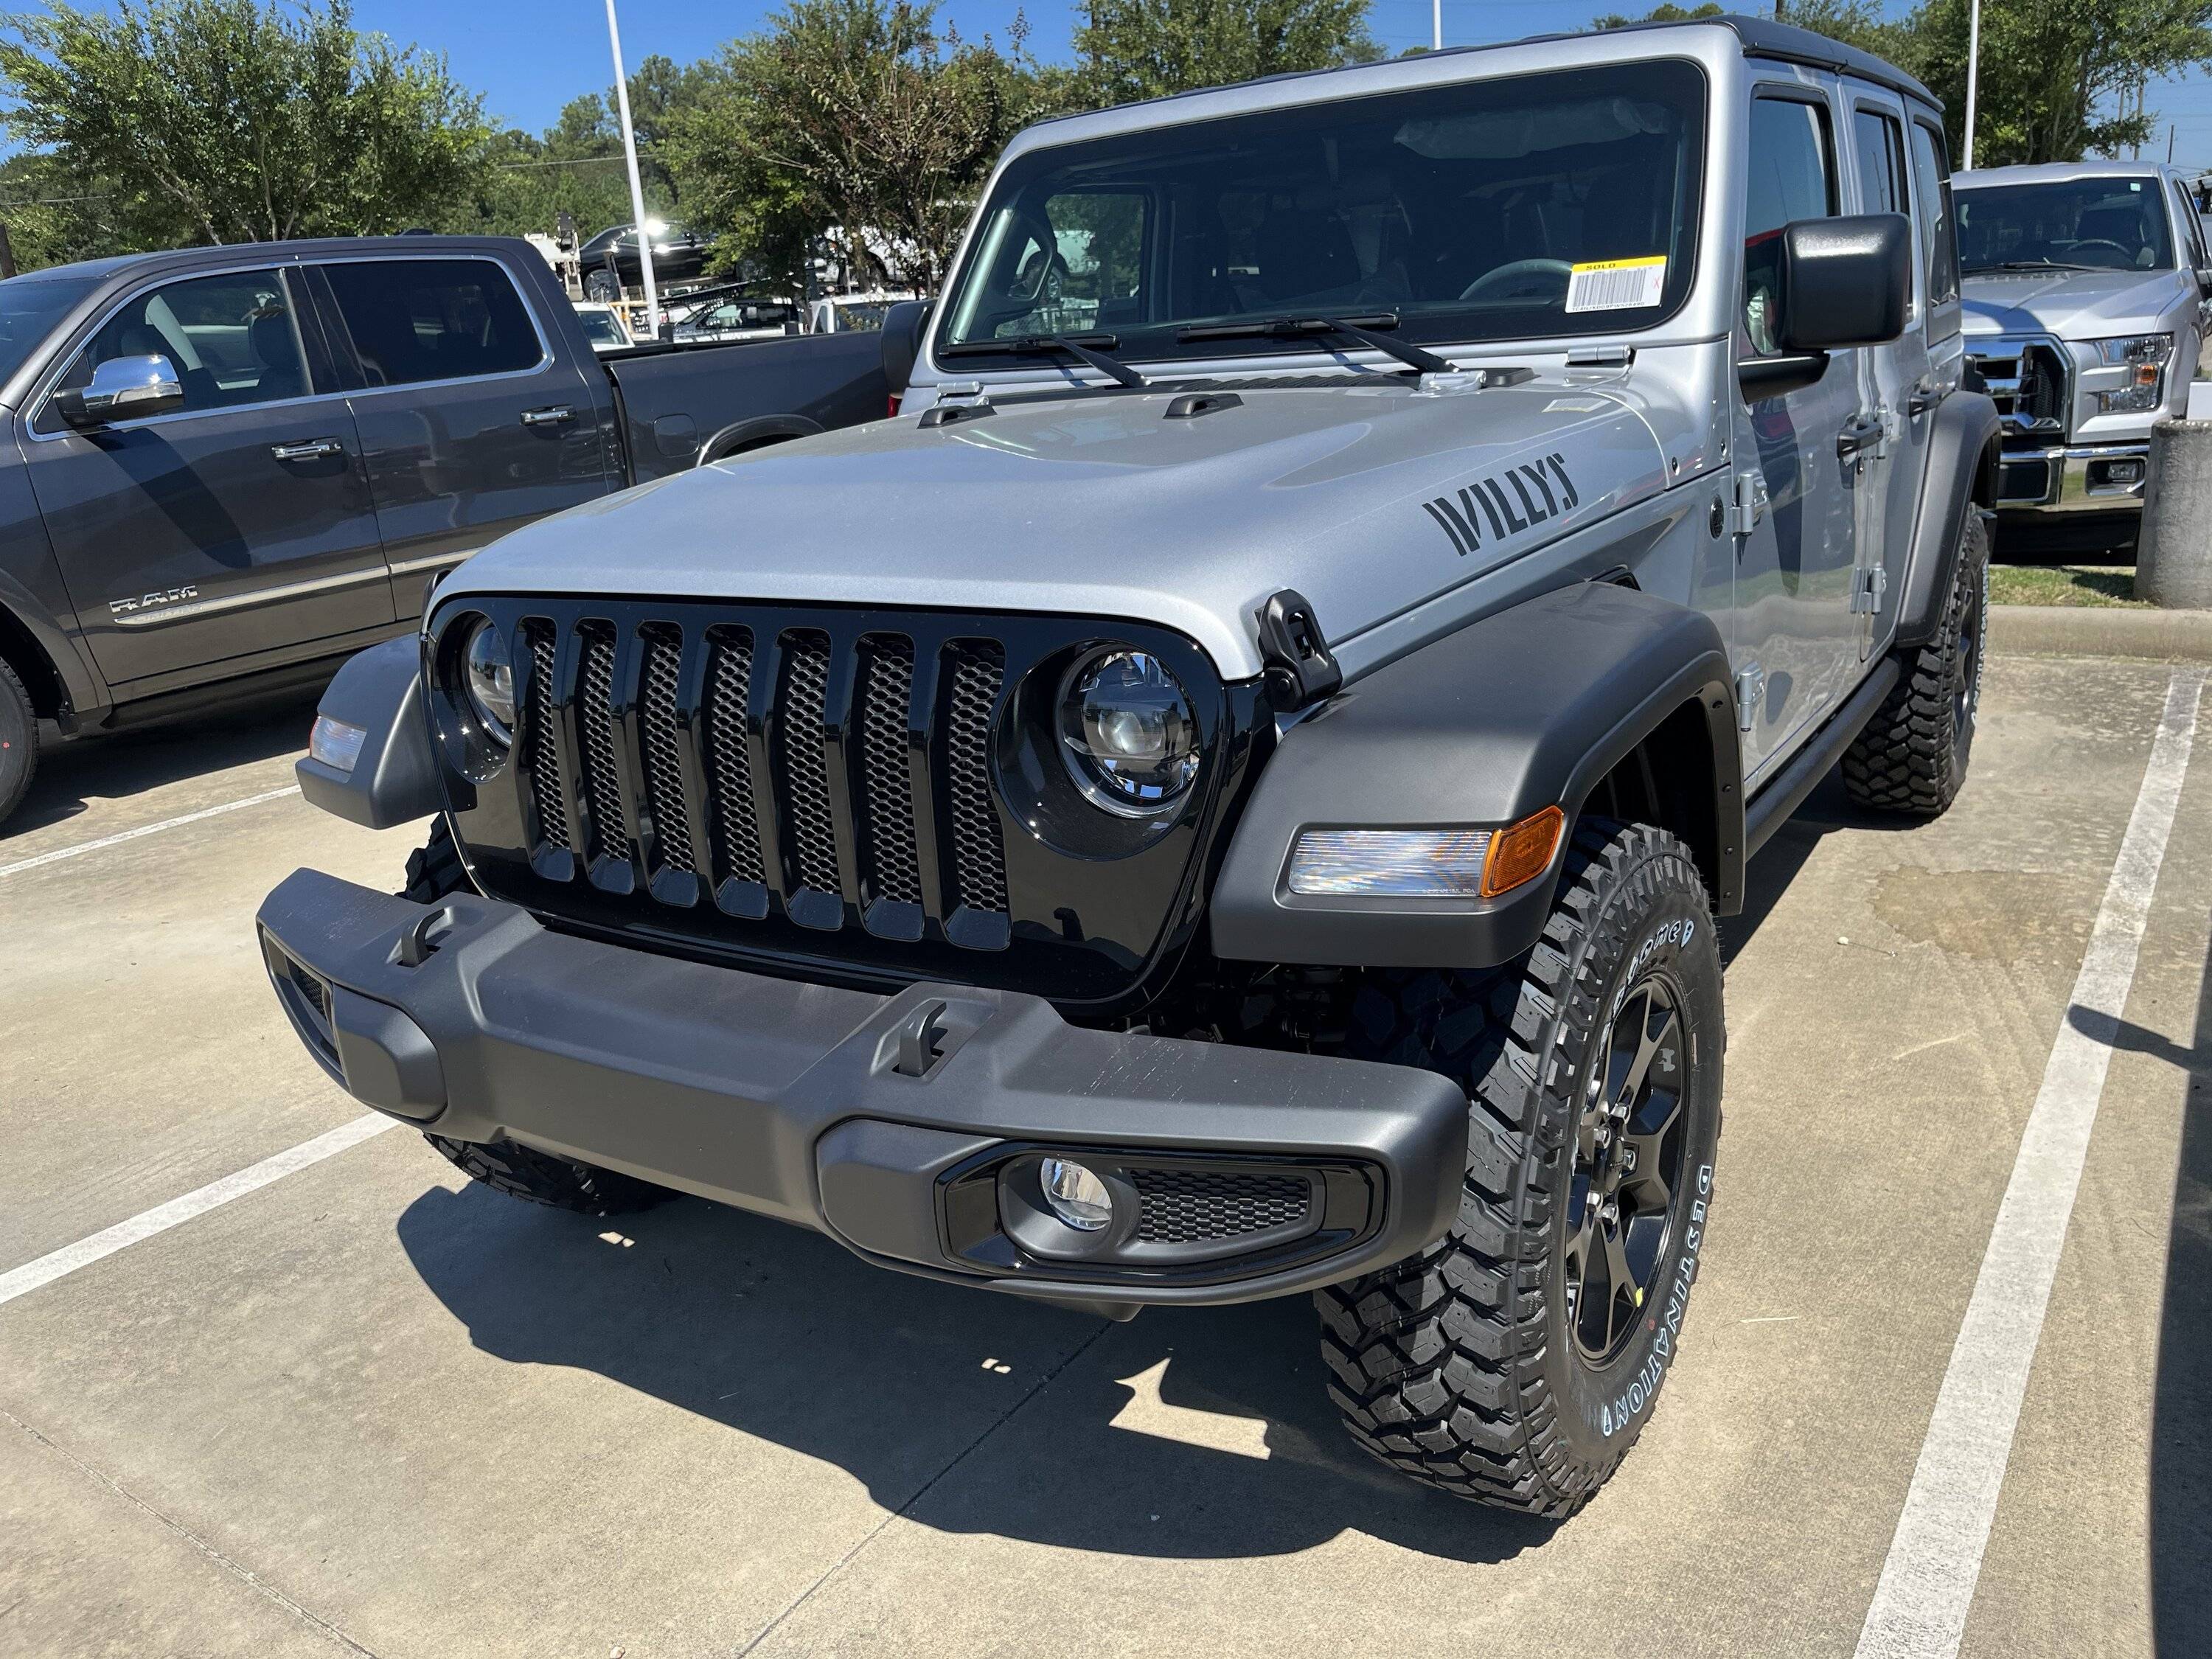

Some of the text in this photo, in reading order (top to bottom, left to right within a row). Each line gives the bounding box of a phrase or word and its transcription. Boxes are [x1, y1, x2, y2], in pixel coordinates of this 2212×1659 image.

[1422, 453, 1579, 557] WILLYS
[108, 585, 198, 613] RAM
[1615, 1164, 1714, 1430] DESTINATION
